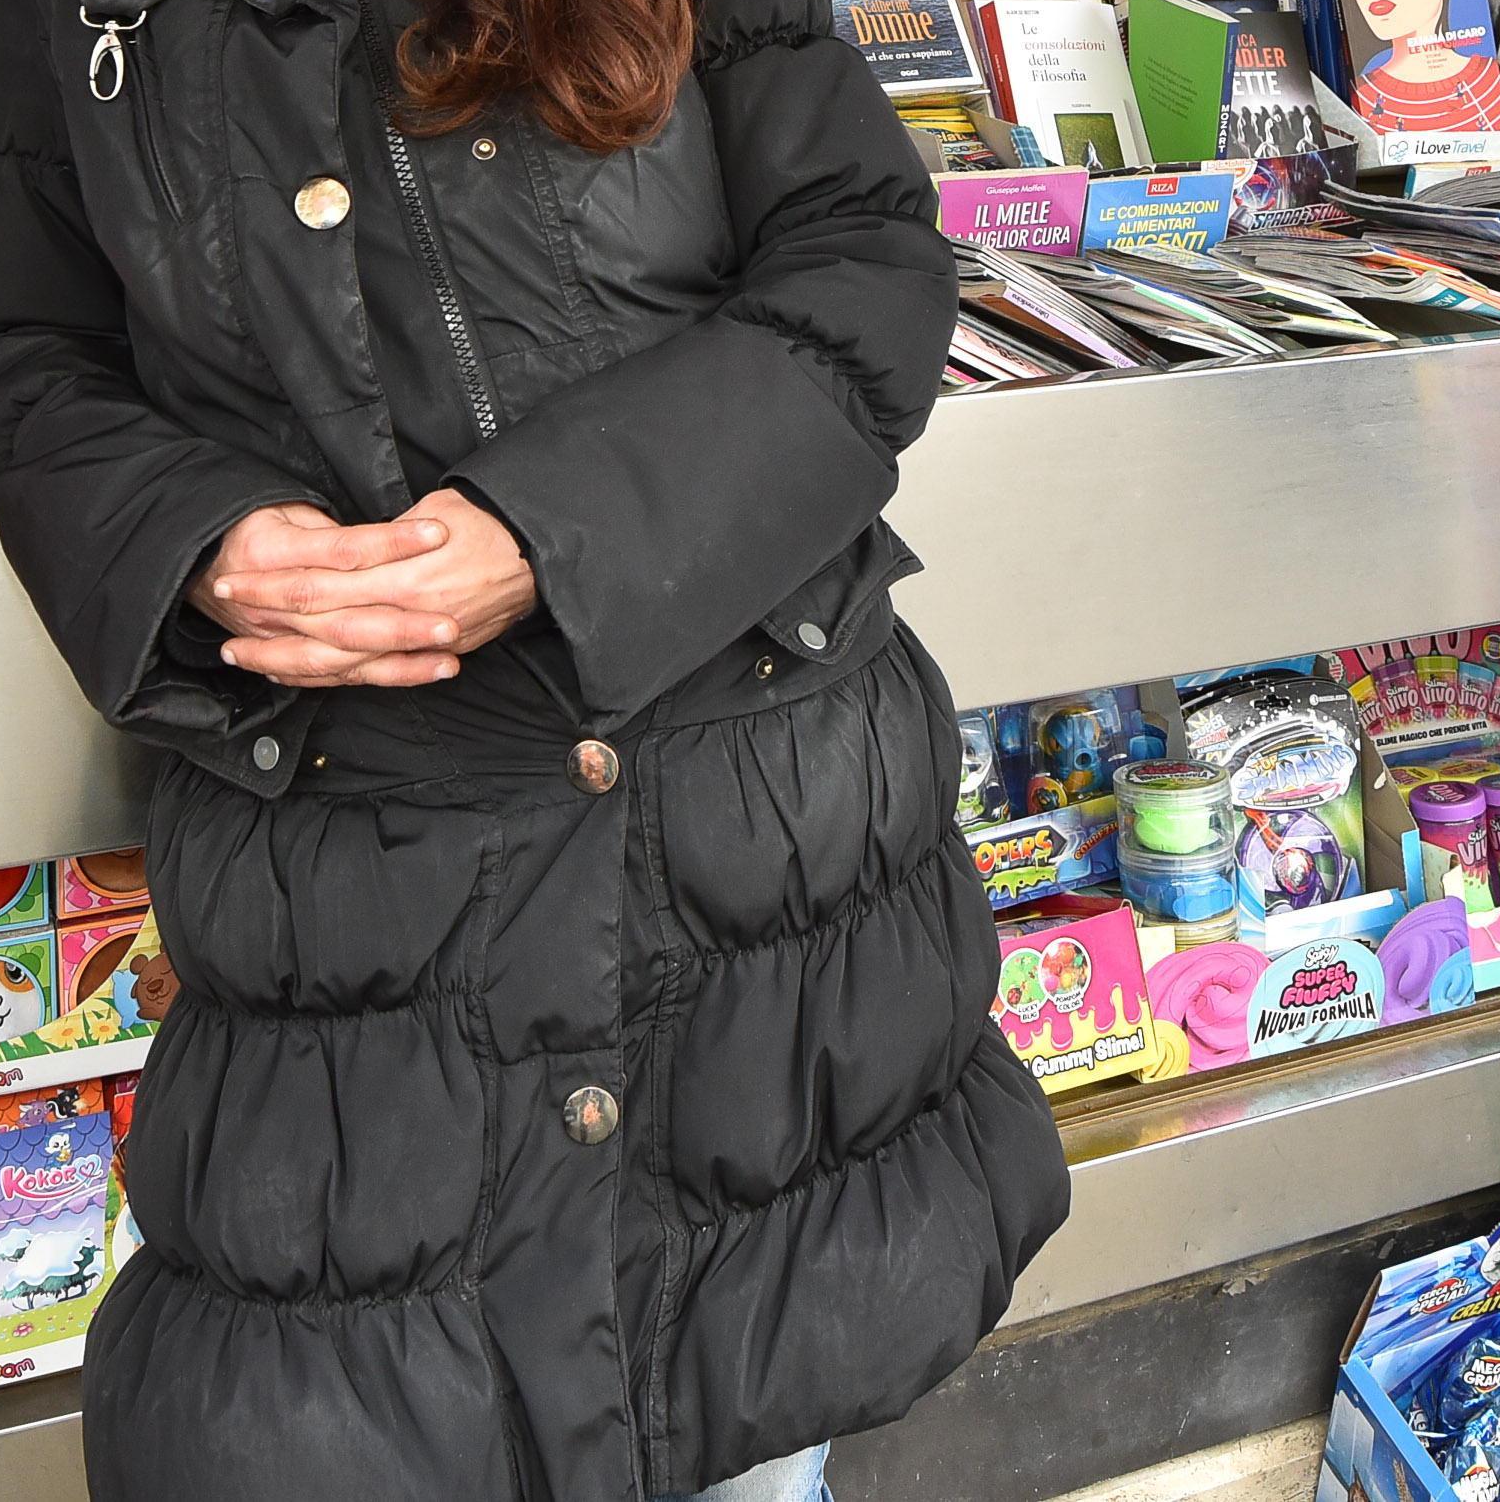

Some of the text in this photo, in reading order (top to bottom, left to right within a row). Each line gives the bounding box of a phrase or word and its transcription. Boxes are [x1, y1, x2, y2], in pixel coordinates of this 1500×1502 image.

[853, 8, 937, 45] Dunne
[1024, 40, 1106, 52] consolazioni
[1031, 69, 1087, 82] Filosofia
[1219, 104, 1230, 153] MOZART
[1152, 182, 1173, 193] RIZA
[994, 200, 1050, 225] MIELE
[1118, 200, 1219, 219] COMBINAZIONI
[969, 225, 1070, 247] MIGLIOR CURA
[1295, 962, 1347, 988] SUPER
[1256, 995, 1376, 1044] NUOVA FORMULA
[1032, 1028, 1145, 1078] Gummy Slime!
